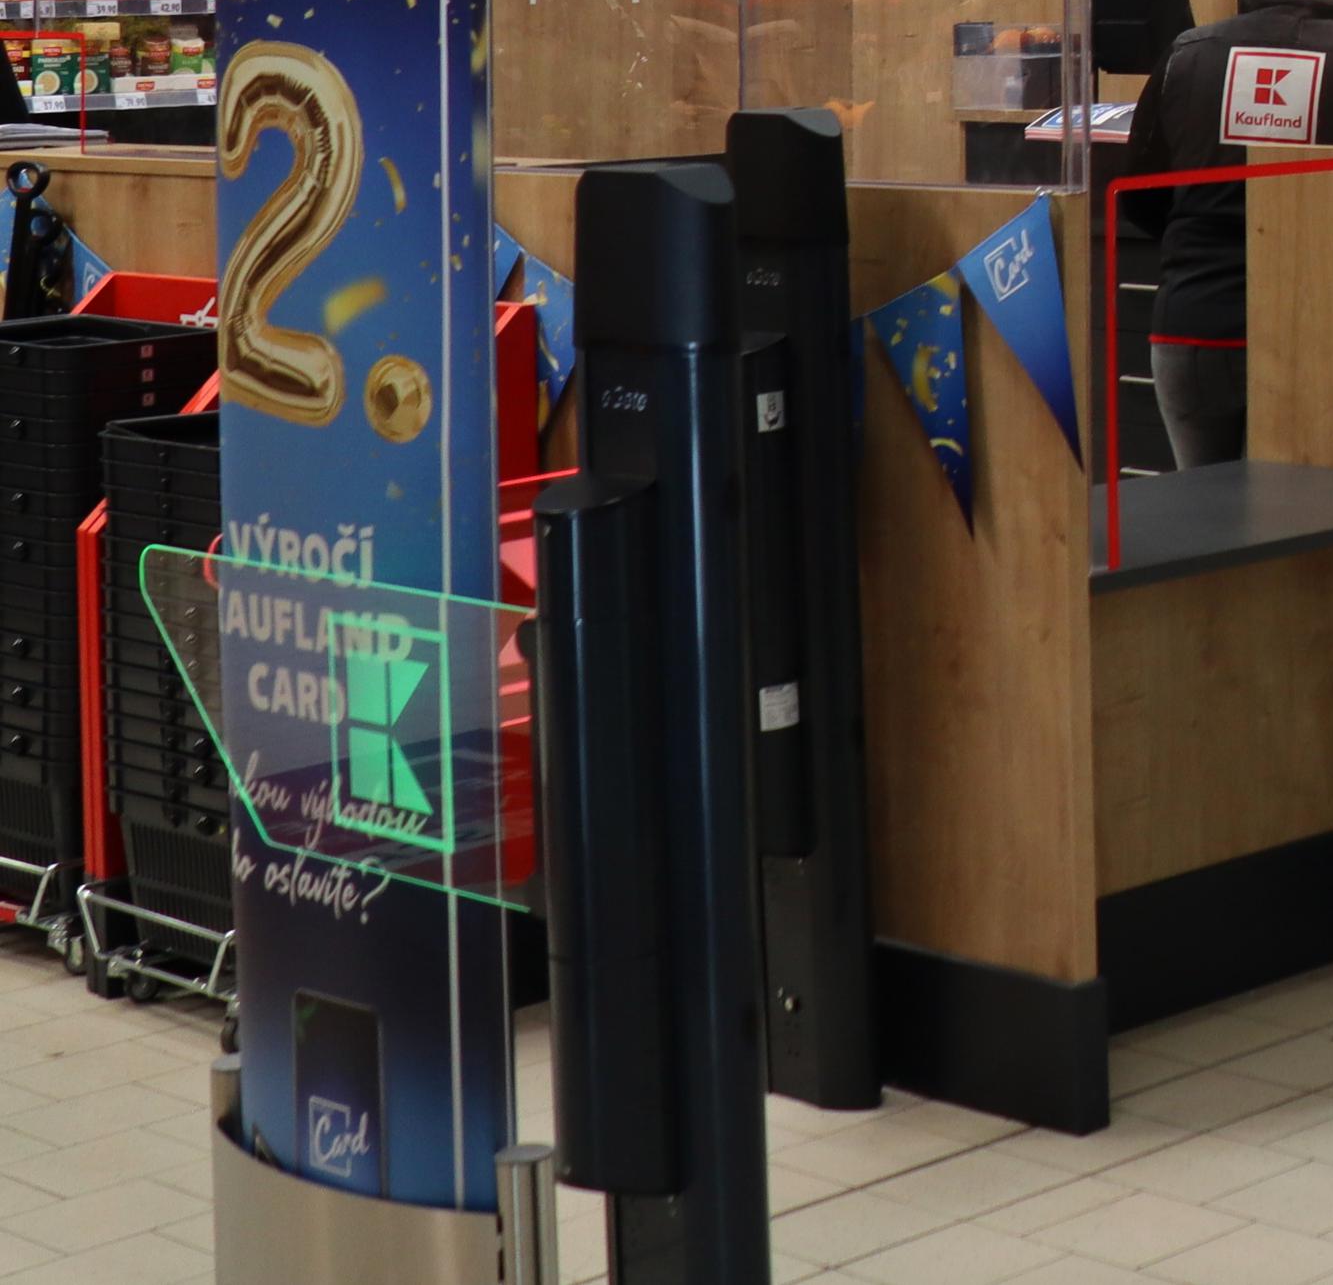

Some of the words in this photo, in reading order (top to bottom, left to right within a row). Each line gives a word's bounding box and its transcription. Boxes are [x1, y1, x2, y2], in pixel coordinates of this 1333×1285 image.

[1234, 110, 1303, 130] Kaufland
[229, 512, 375, 590] VÝROČÍ
[221, 587, 415, 663] AUFLAND
[247, 661, 347, 726] CARD
[314, 1110, 372, 1164] Card
